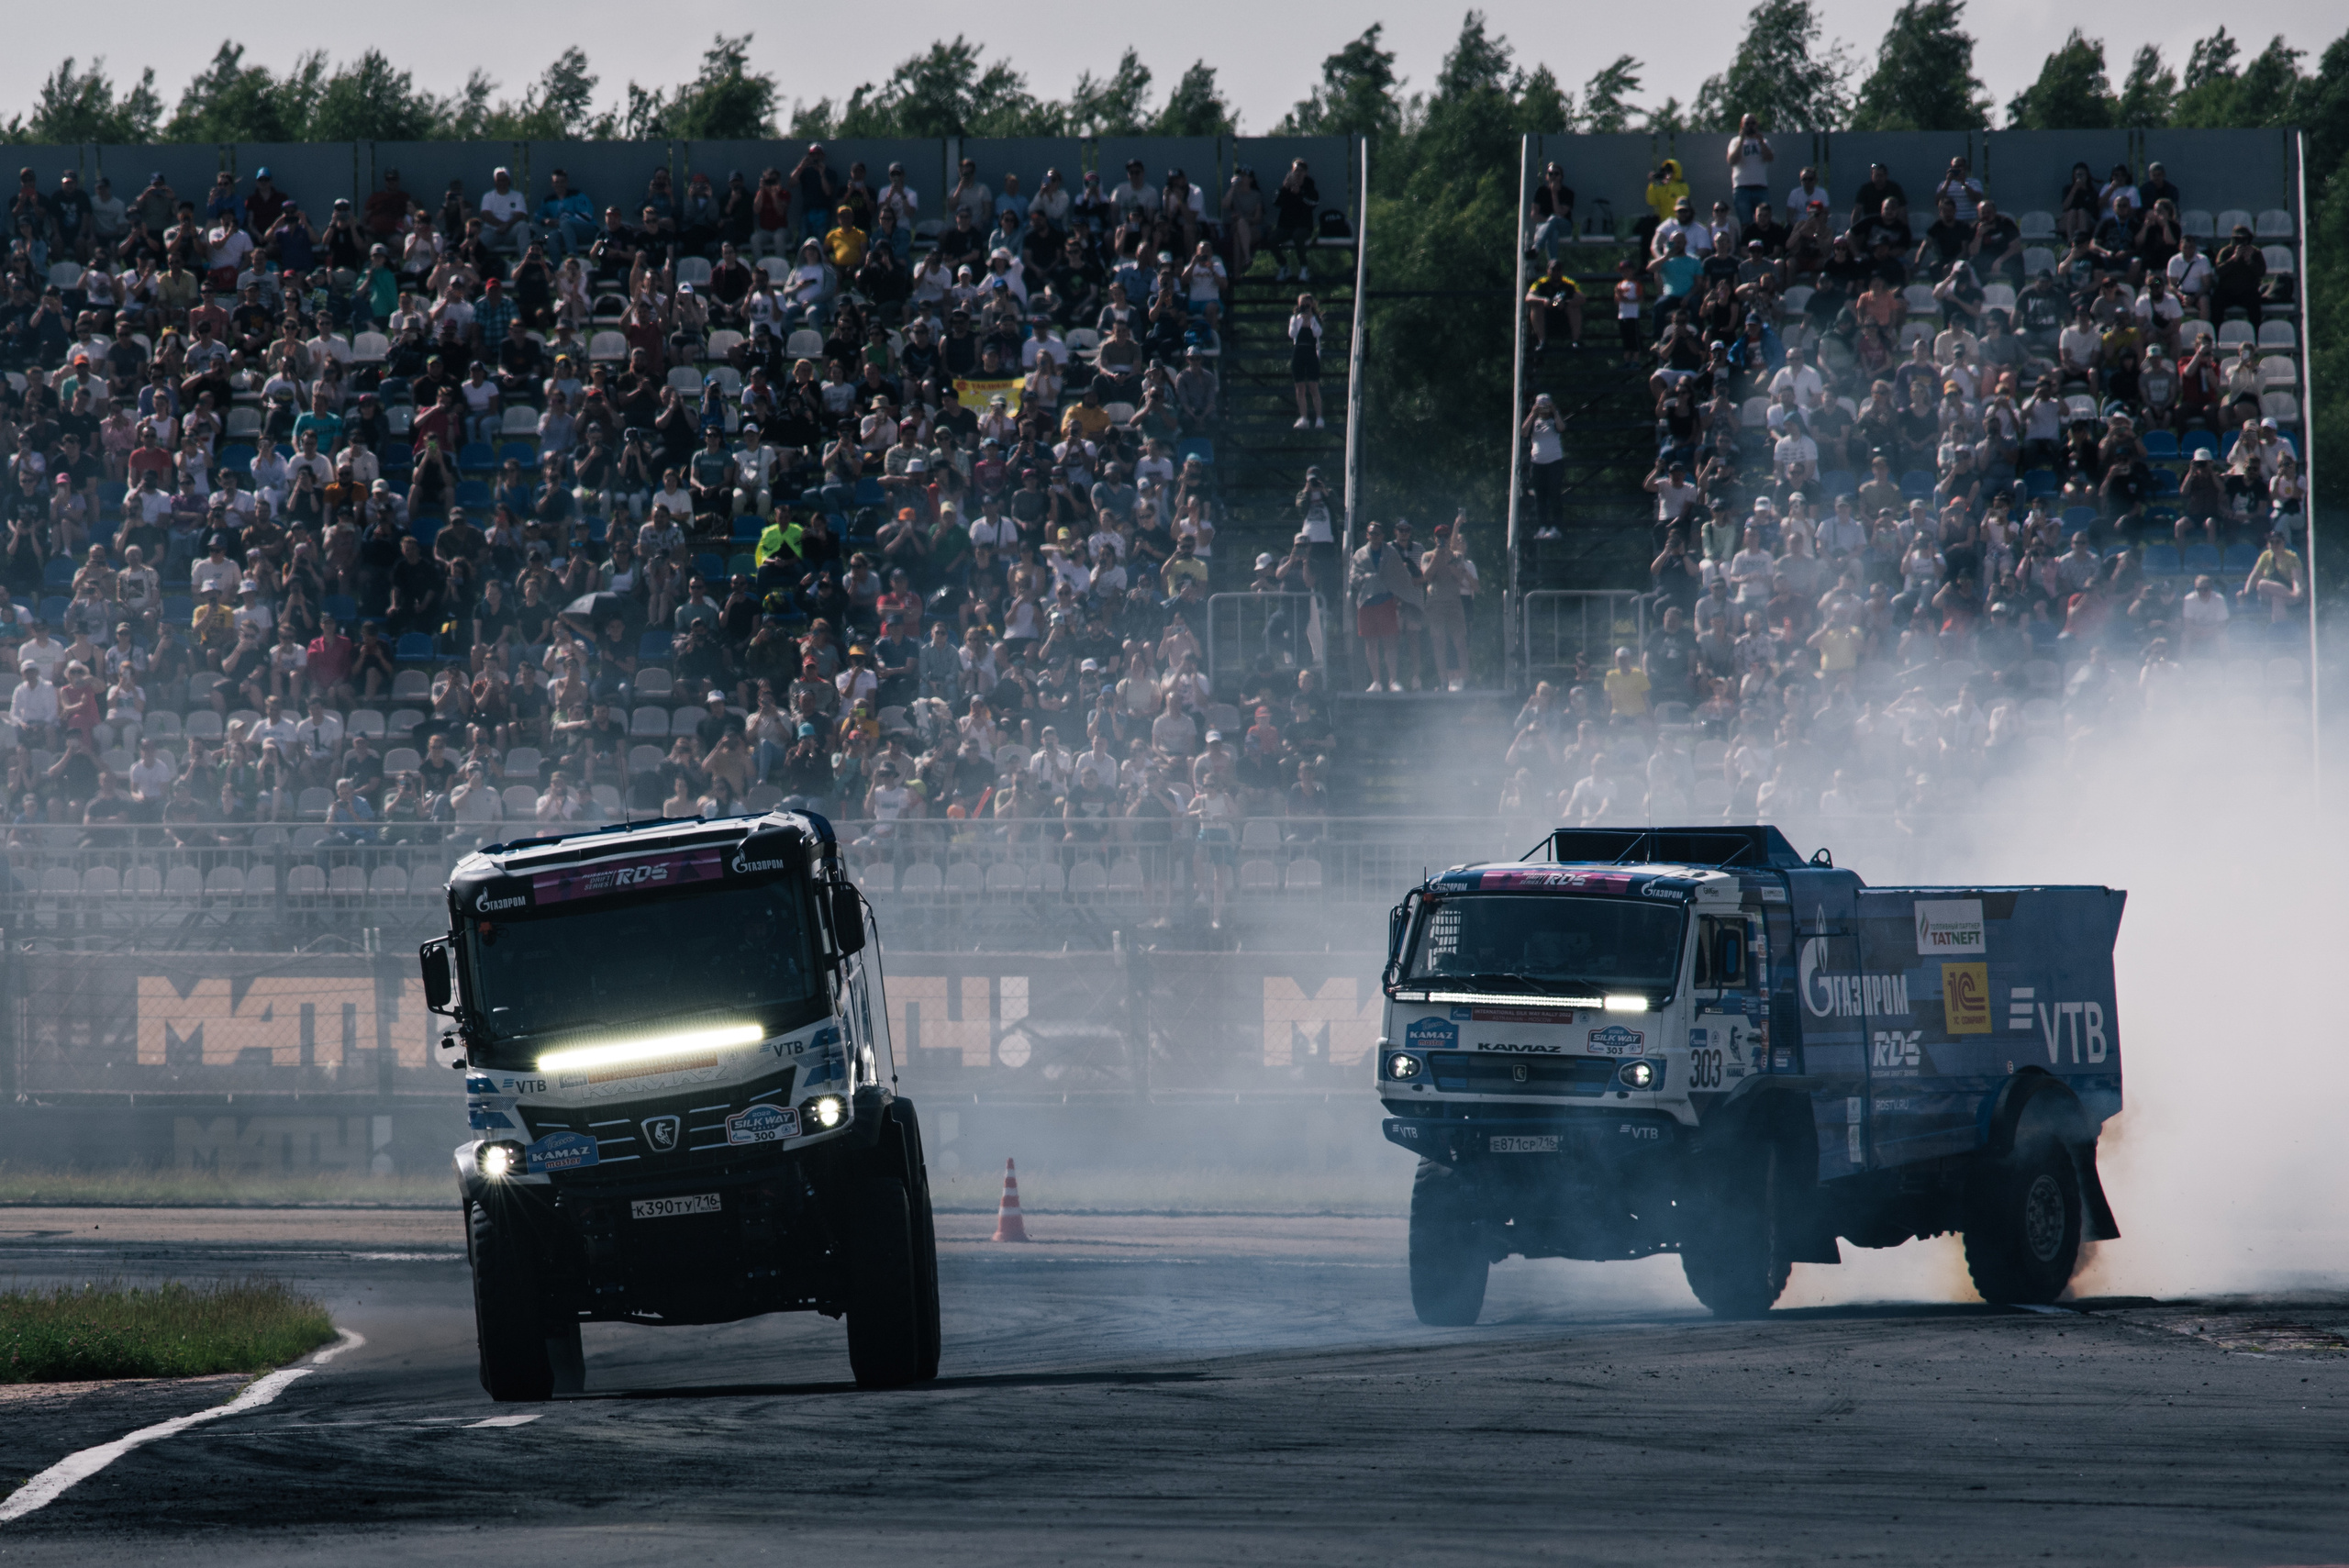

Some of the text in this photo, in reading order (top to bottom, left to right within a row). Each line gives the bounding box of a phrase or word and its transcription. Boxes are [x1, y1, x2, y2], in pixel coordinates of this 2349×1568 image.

[590, 876, 611, 884] DRIFT
[615, 862, 671, 886] RDS
[1543, 873, 1592, 886] RDS
[584, 882, 609, 891] SERIES
[490, 895, 527, 911] ГАЗПРОМ
[1931, 930, 1981, 946] TATNEFT
[1834, 974, 1909, 1017] ГАЗПРОМ
[2039, 1001, 2108, 1064] VTB
[774, 1040, 804, 1057] VTB
[1478, 1043, 1561, 1052] KAMAZ
[1873, 1030, 1922, 1066] RDS
[1689, 1049, 1722, 1088] 303
[516, 1080, 546, 1094] VTB
[734, 1114, 791, 1129] SILK WAY
[754, 1131, 775, 1141] 300
[1400, 1127, 1418, 1139] VTB
[1631, 1127, 1659, 1140] VTB
[1538, 1137, 1554, 1148] 716
[532, 1147, 590, 1162] KAMAZ
[546, 1157, 581, 1169] master
[695, 1195, 716, 1207] 716
